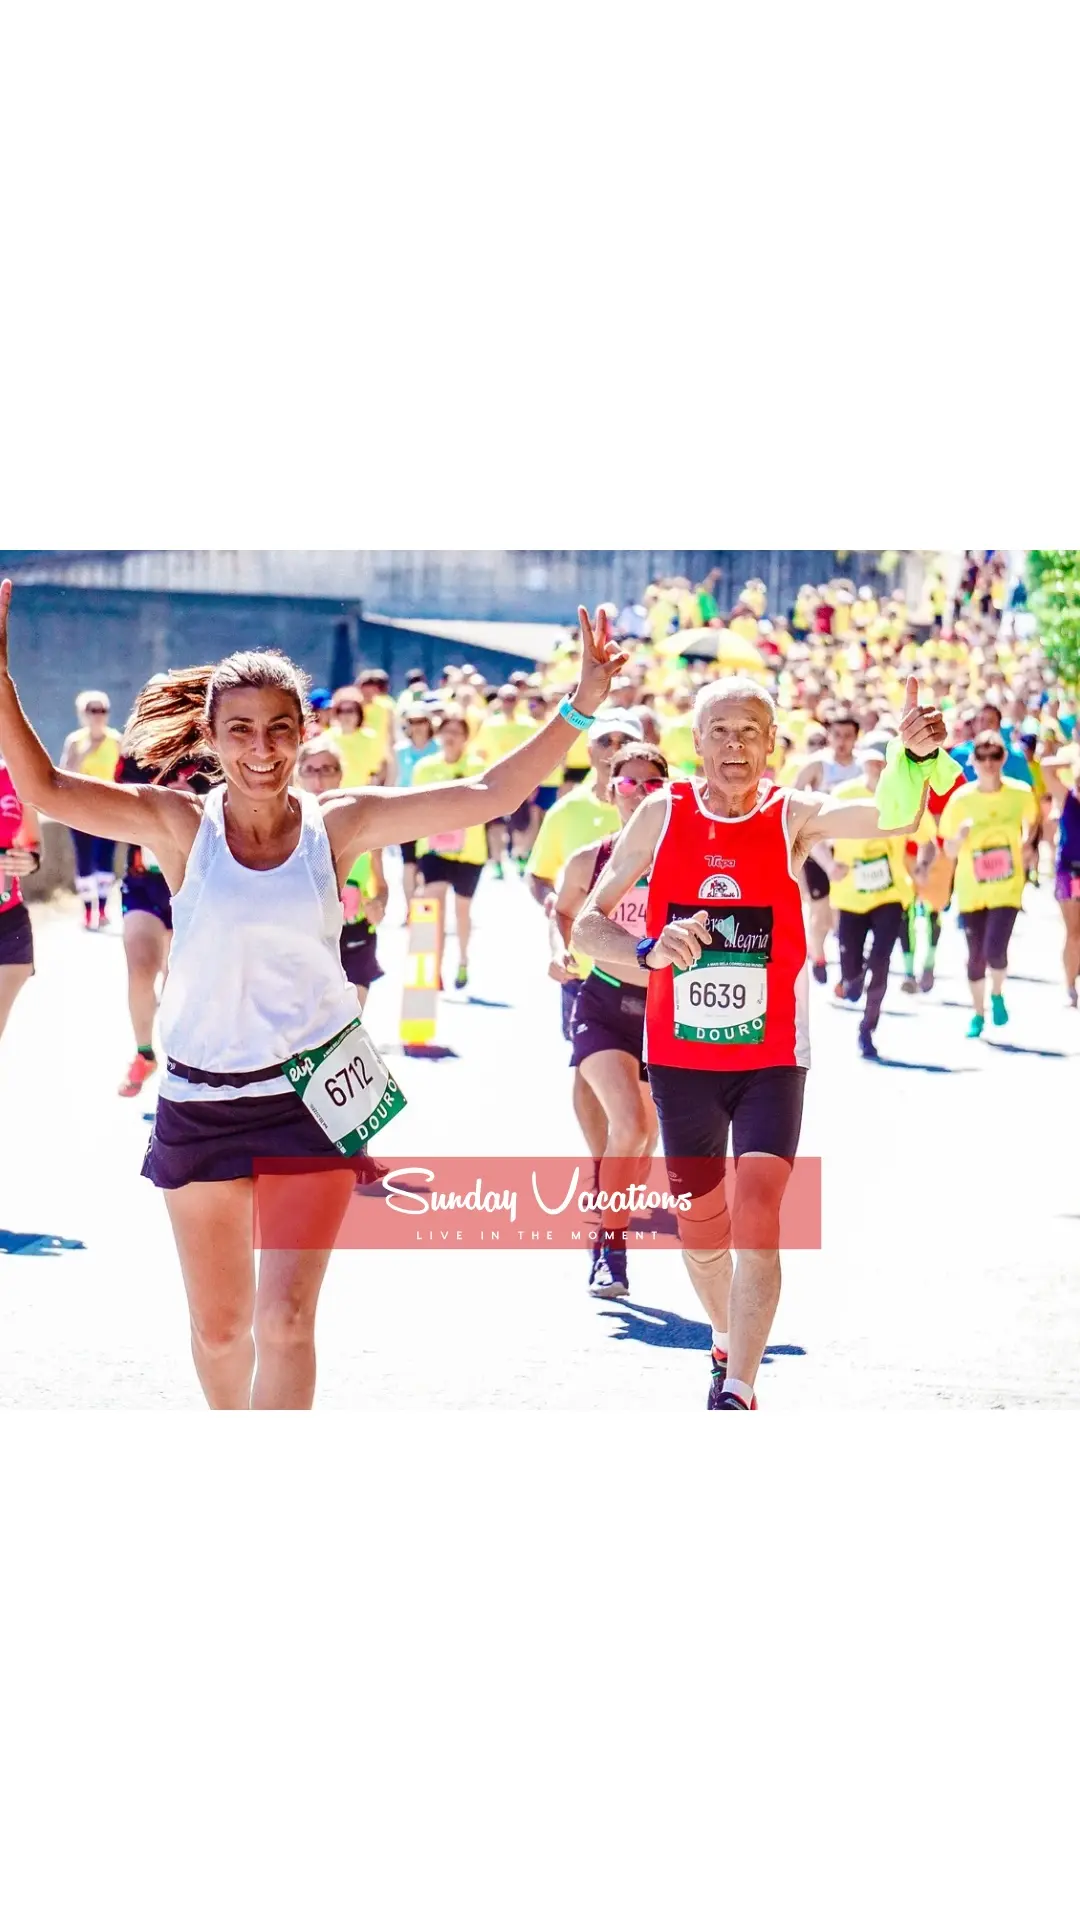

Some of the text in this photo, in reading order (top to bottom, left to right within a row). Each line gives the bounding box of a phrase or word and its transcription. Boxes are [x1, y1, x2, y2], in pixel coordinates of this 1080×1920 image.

[689, 981, 746, 1009] 6639
[696, 1018, 763, 1041] DOURO
[325, 1056, 374, 1107] 6712
[356, 1079, 398, 1140] DOURO
